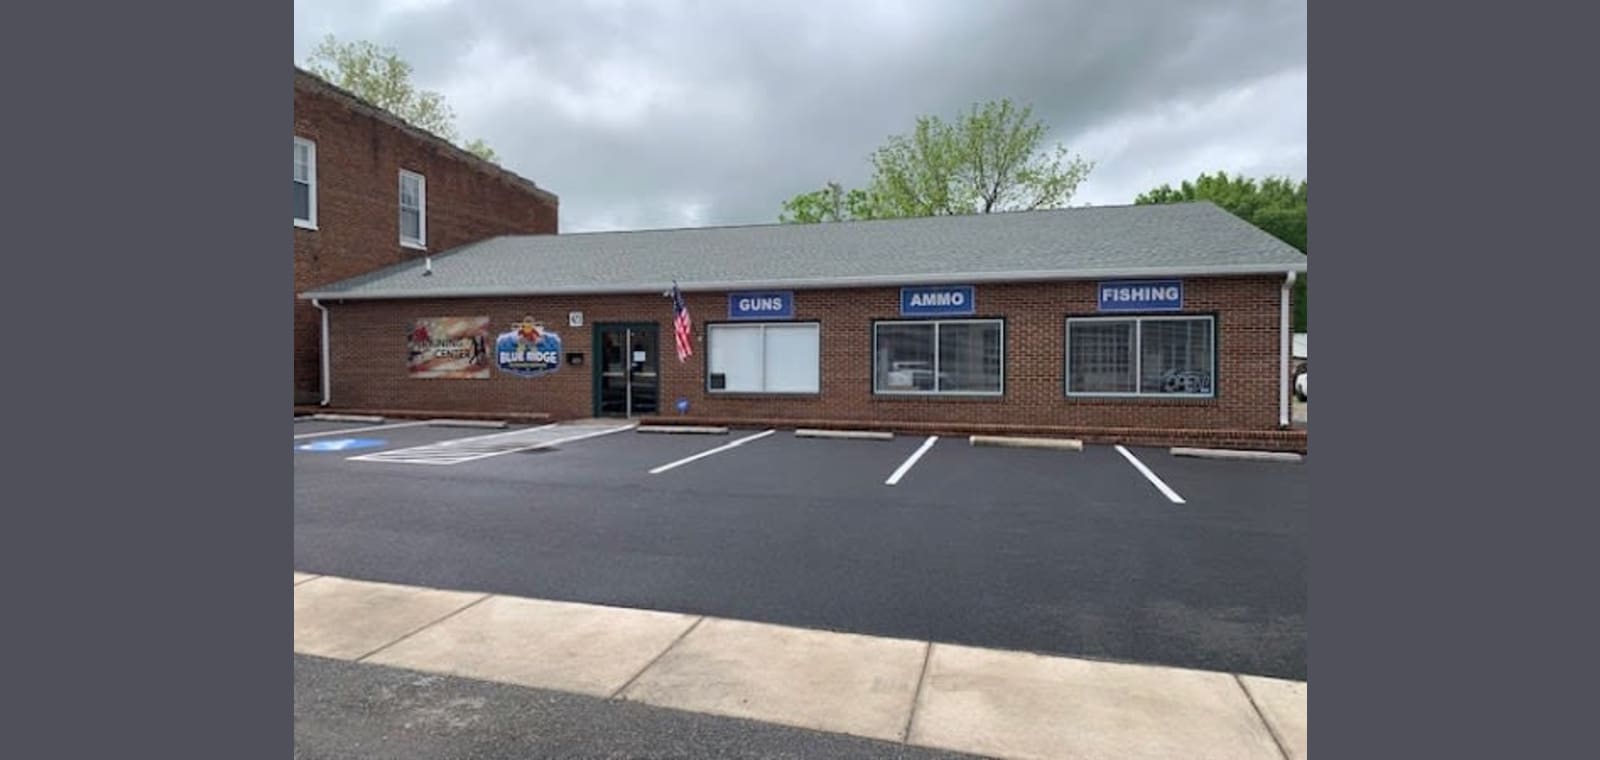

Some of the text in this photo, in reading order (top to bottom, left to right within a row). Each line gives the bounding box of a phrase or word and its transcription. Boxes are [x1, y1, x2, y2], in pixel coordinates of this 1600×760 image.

[910, 291, 965, 306] AMMO
[1102, 286, 1178, 302] FISHING
[739, 297, 782, 311] GUNS
[500, 351, 558, 364] BLUE RIDGE
